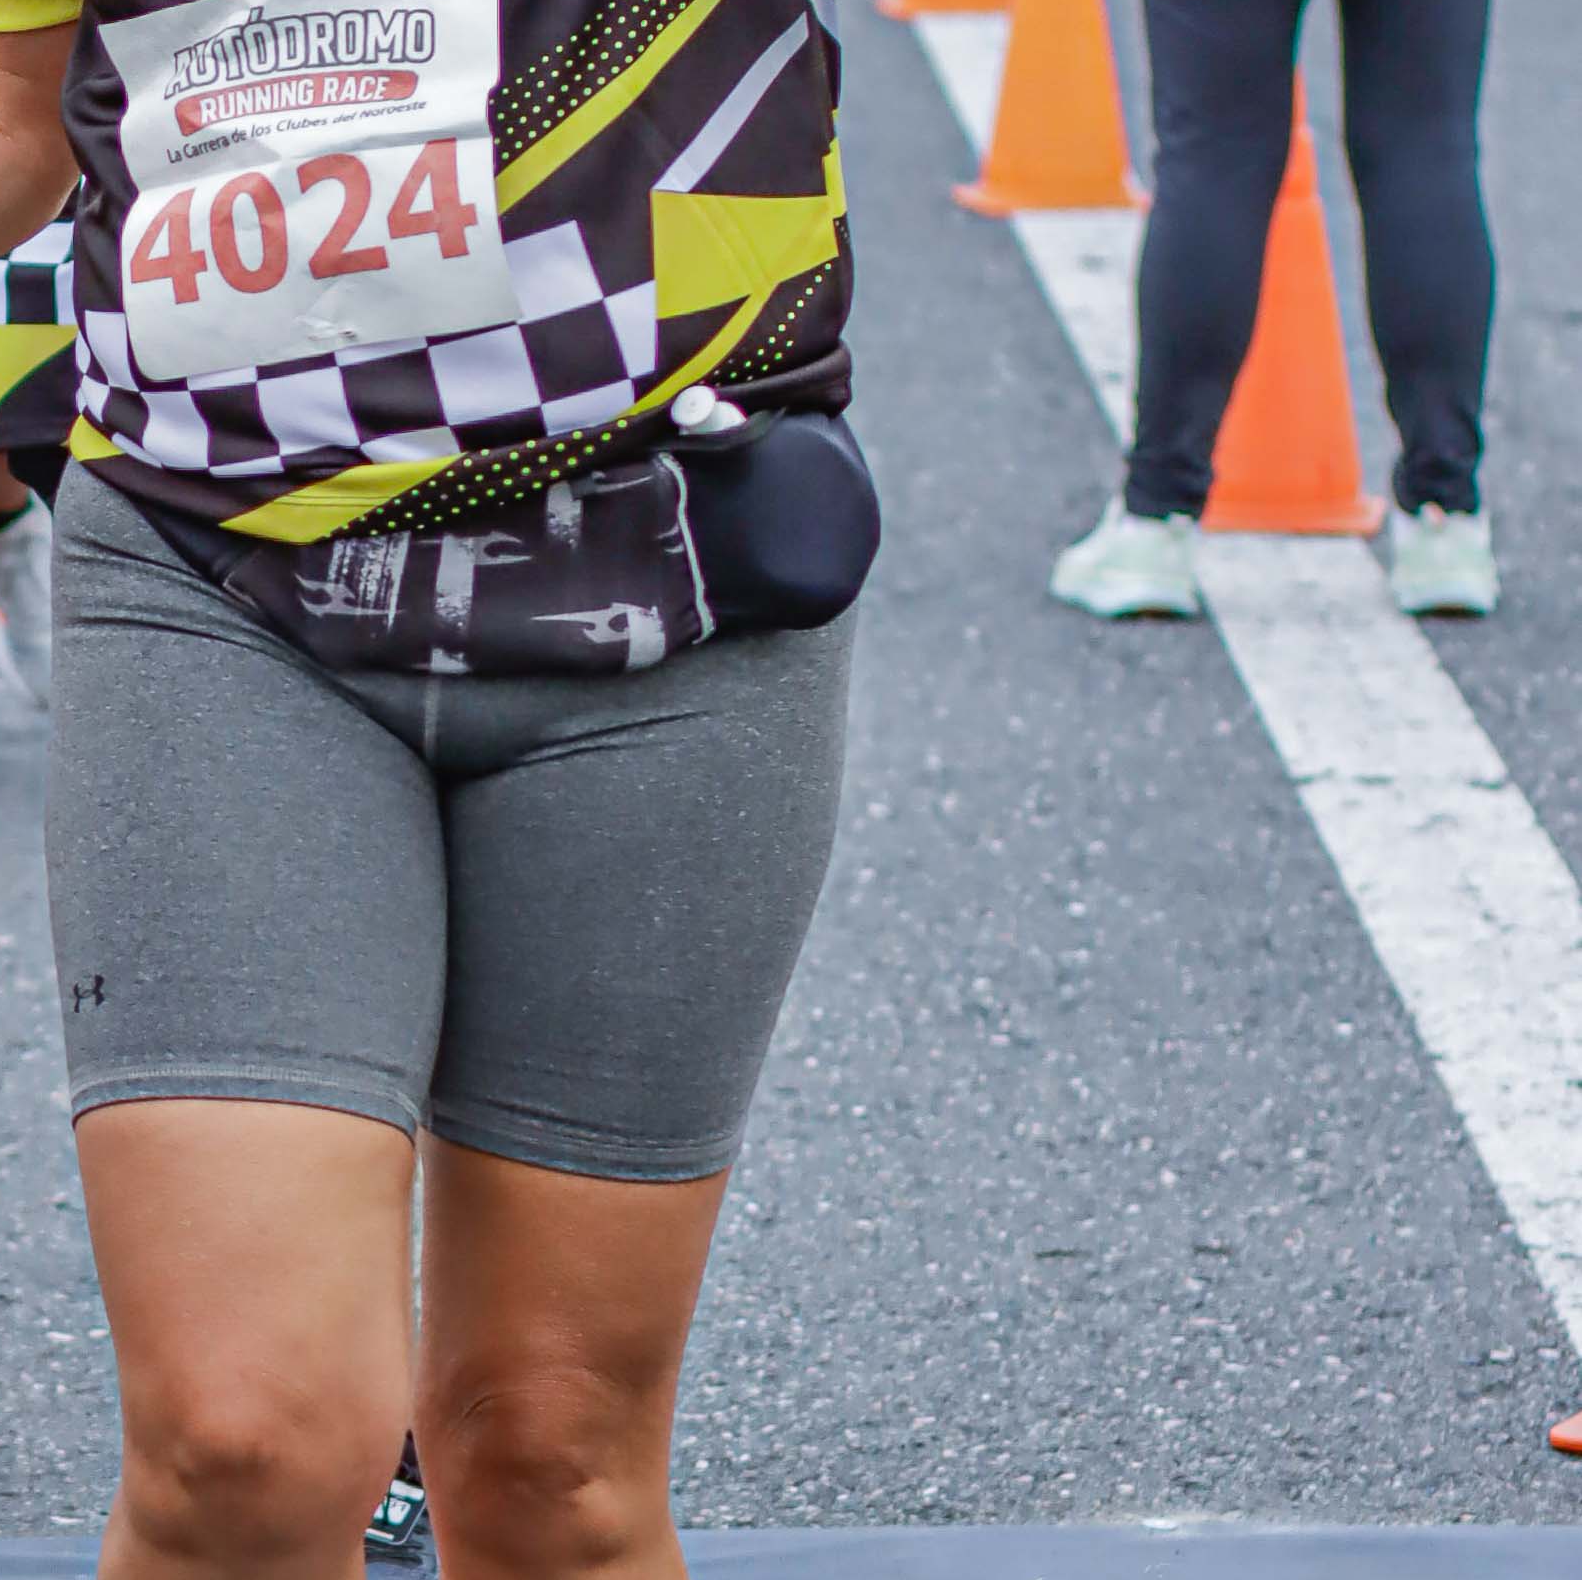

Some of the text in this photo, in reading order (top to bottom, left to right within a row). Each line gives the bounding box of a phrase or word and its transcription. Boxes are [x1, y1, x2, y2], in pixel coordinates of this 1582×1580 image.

[164, 6, 436, 99] AUTÓDROMO
[167, 99, 428, 164] La Carrera de los Clubes del Noroeste
[199, 75, 391, 125] RUNNING RACE
[130, 138, 480, 305] 4024
